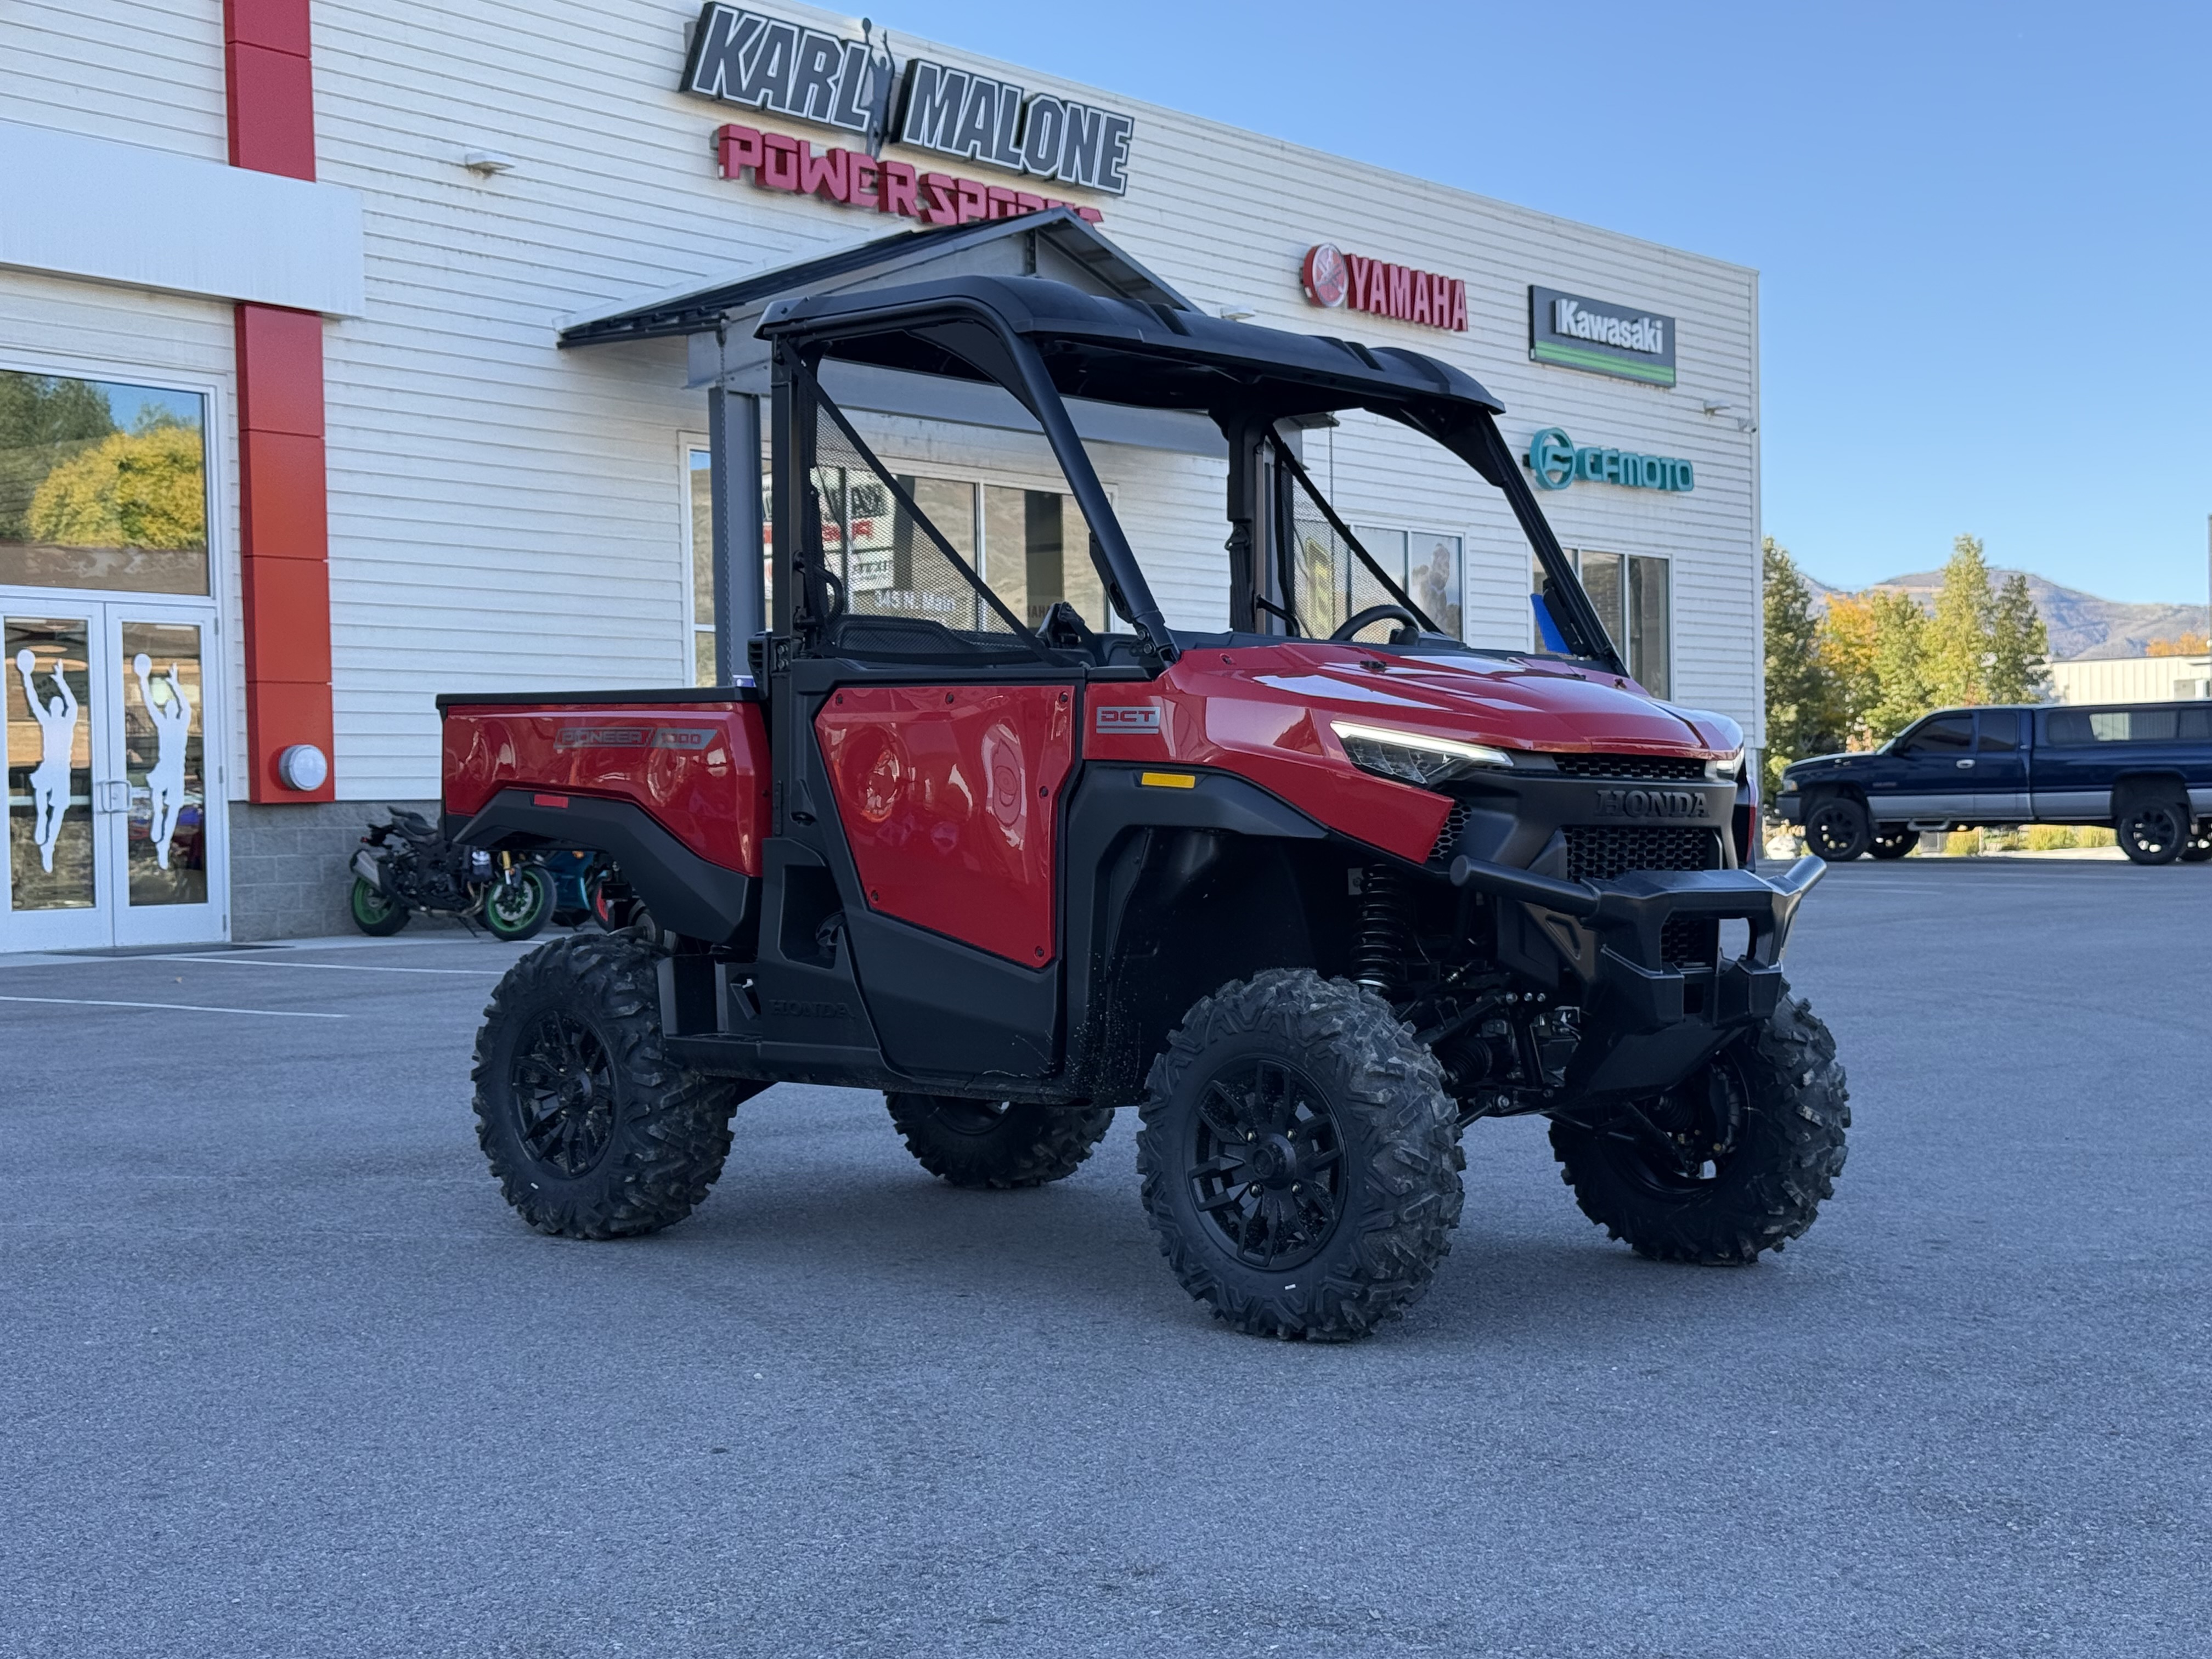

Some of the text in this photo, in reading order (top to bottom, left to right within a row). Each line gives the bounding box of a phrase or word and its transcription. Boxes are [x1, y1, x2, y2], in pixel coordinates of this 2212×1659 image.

[690, 5, 1134, 195] KARL MALONE
[1346, 254, 1469, 331] YAMAHA
[1555, 299, 1663, 354] Kawasaki
[1576, 447, 1694, 492] CFMOTO
[1101, 710, 1156, 723] DCT
[562, 731, 643, 743] PIONEER
[1596, 789, 1710, 819] HONDA
[768, 999, 856, 1019] HONDA
